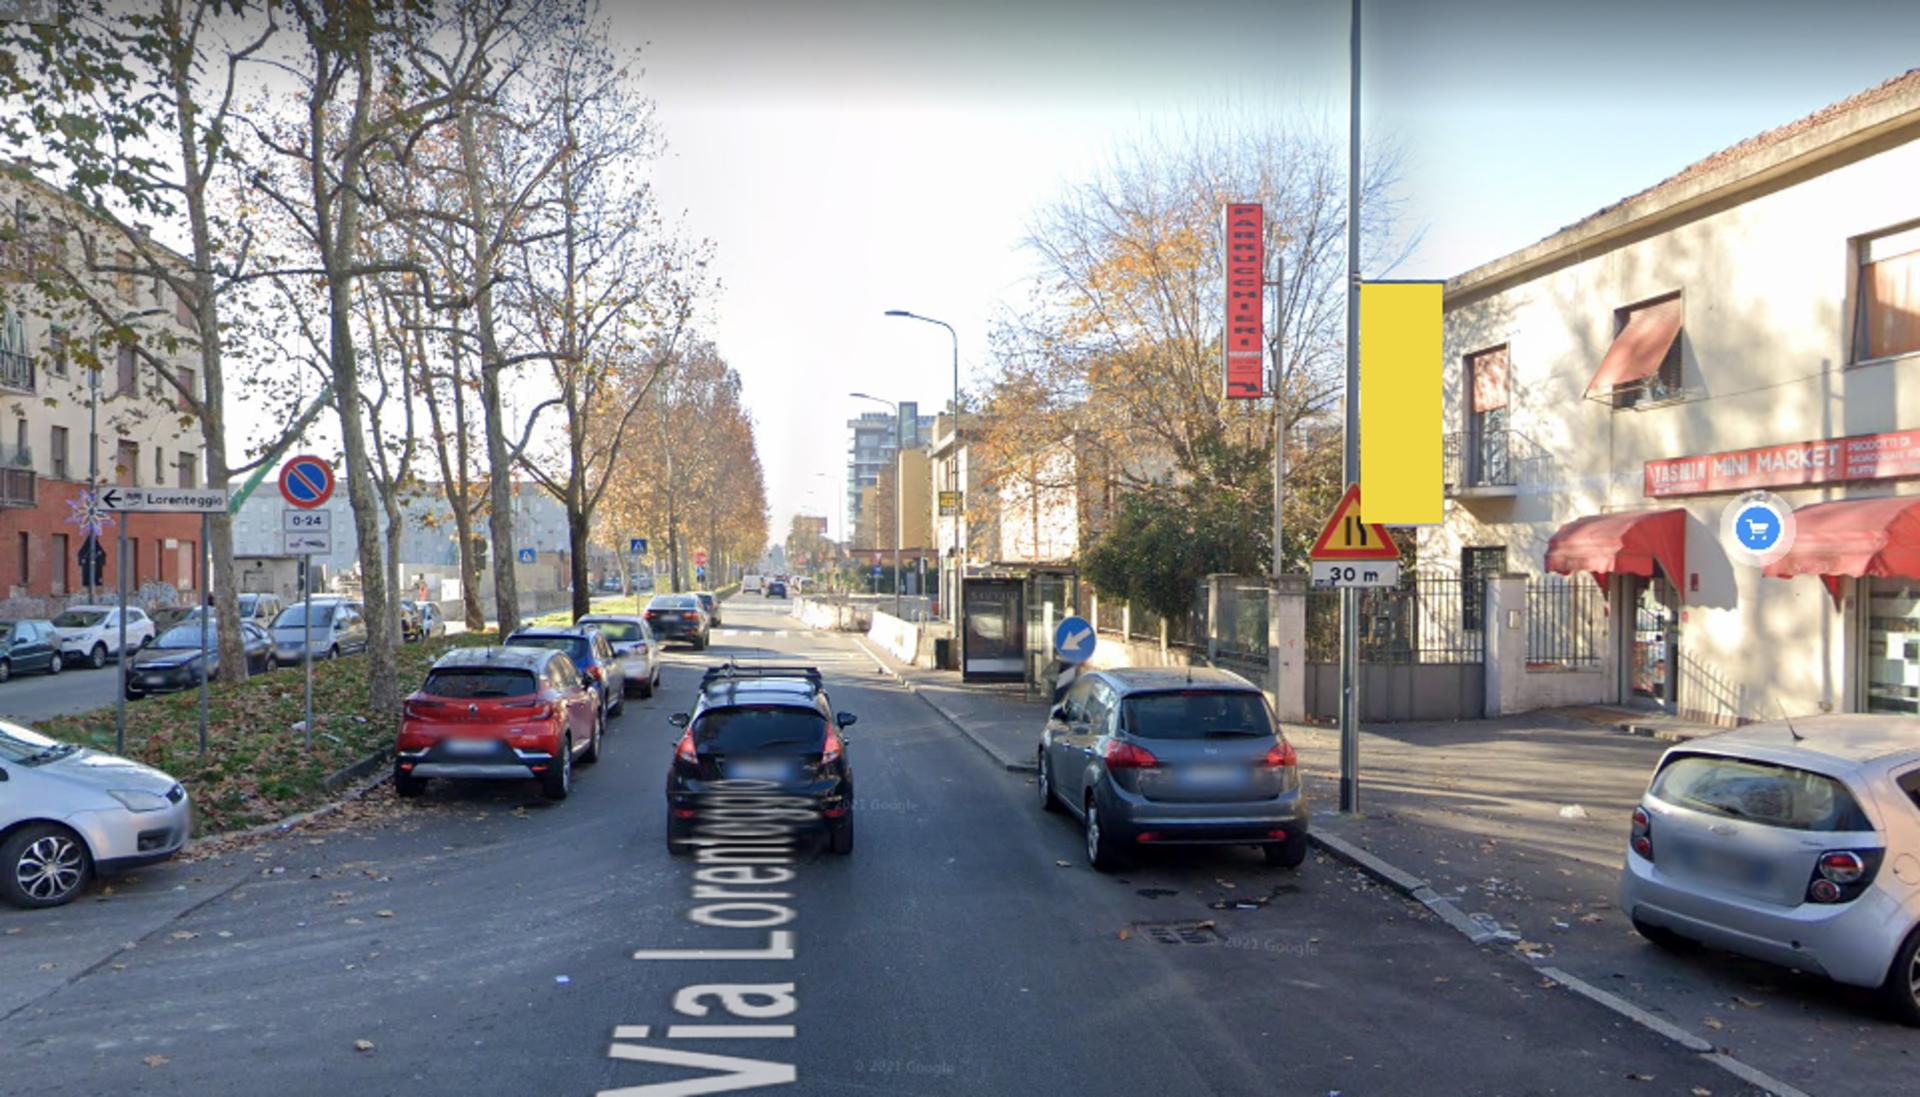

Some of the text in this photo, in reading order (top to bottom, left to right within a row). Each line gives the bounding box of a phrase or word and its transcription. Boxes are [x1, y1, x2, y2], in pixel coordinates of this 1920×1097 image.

[1233, 207, 1257, 347] PARRUCCHIERI
[1712, 454, 1749, 479] MINI
[1756, 442, 1840, 474] MARKET
[147, 493, 223, 508] Lorenteggio
[293, 515, 322, 526] 0-24
[1330, 567, 1378, 582] 30 m
